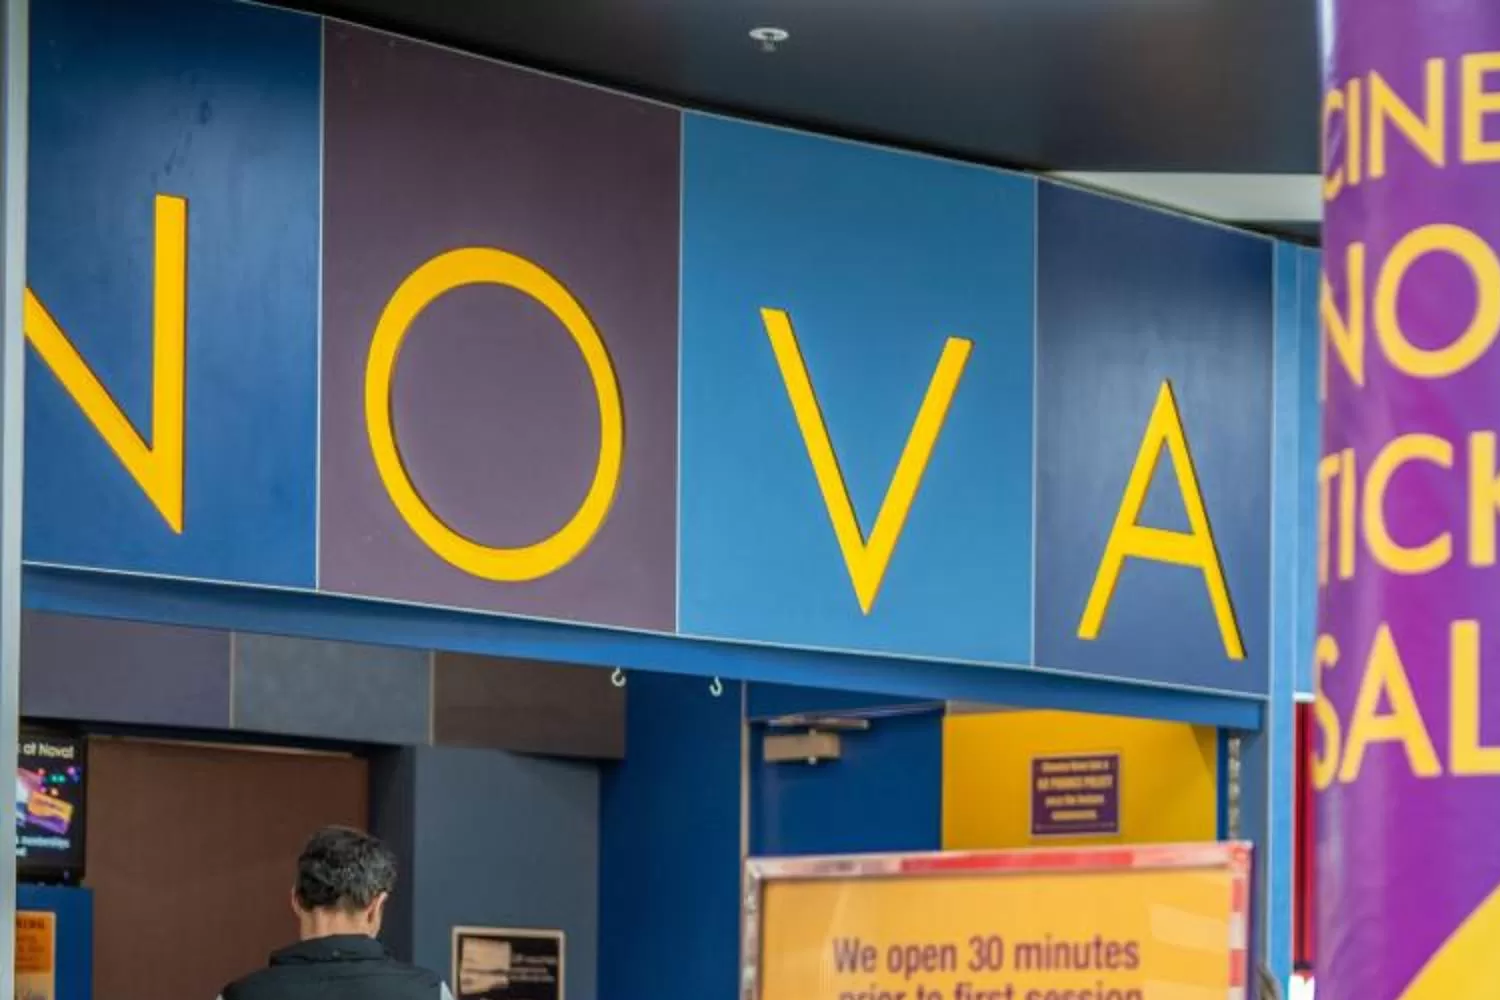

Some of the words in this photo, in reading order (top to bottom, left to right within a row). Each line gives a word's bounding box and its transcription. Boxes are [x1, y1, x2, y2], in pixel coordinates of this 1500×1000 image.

[22, 194, 1246, 660] NOVA
[833, 937, 877, 974] We
[887, 940, 957, 981] open
[968, 936, 1004, 972] 30
[1013, 935, 1140, 972] minutes
